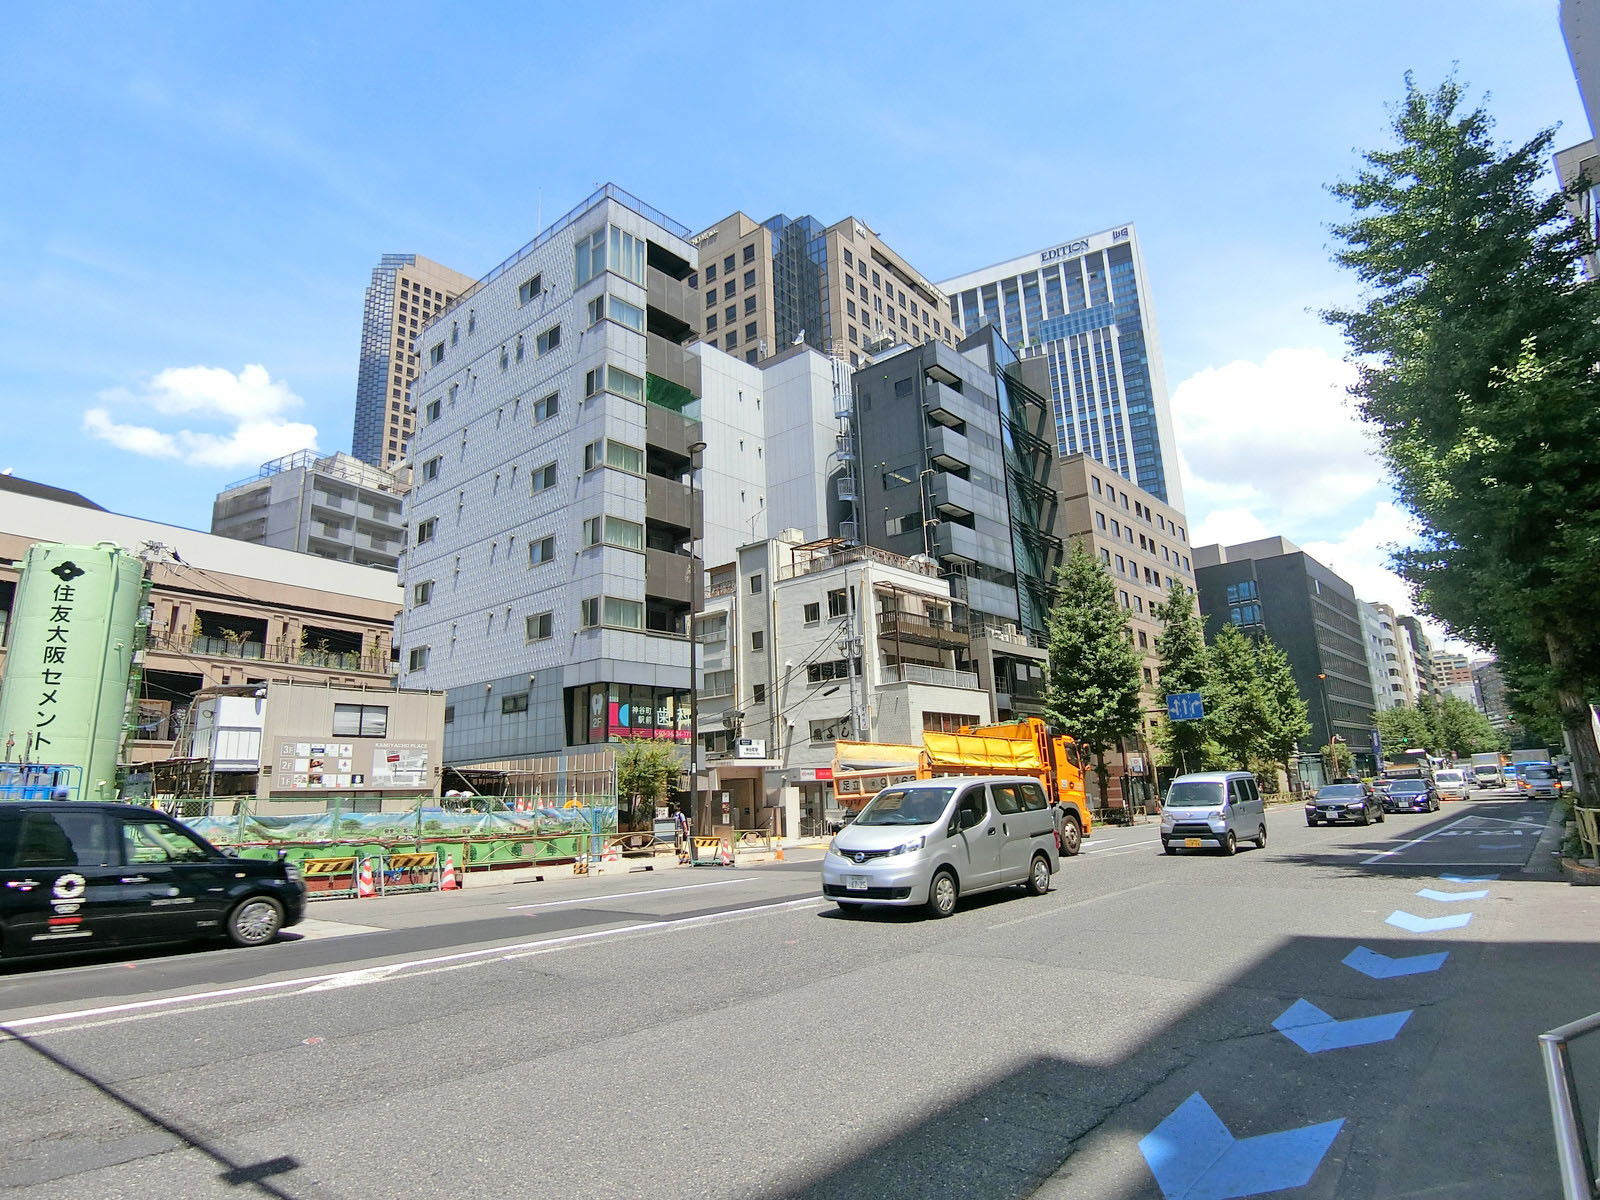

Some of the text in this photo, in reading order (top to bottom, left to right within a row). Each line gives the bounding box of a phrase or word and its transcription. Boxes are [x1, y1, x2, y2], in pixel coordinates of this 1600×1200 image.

[1041, 239, 1089, 262] EDITION
[35, 584, 76, 751] 住友大阪セメント
[632, 706, 652, 715] 神谷町
[656, 703, 692, 726] 歯科
[592, 717, 602, 728] 2F
[638, 715, 652, 725] 駅前
[283, 745, 294, 754] 3F
[281, 760, 292, 769] 2F
[281, 776, 291, 785] 1F
[843, 779, 860, 792] 足立
